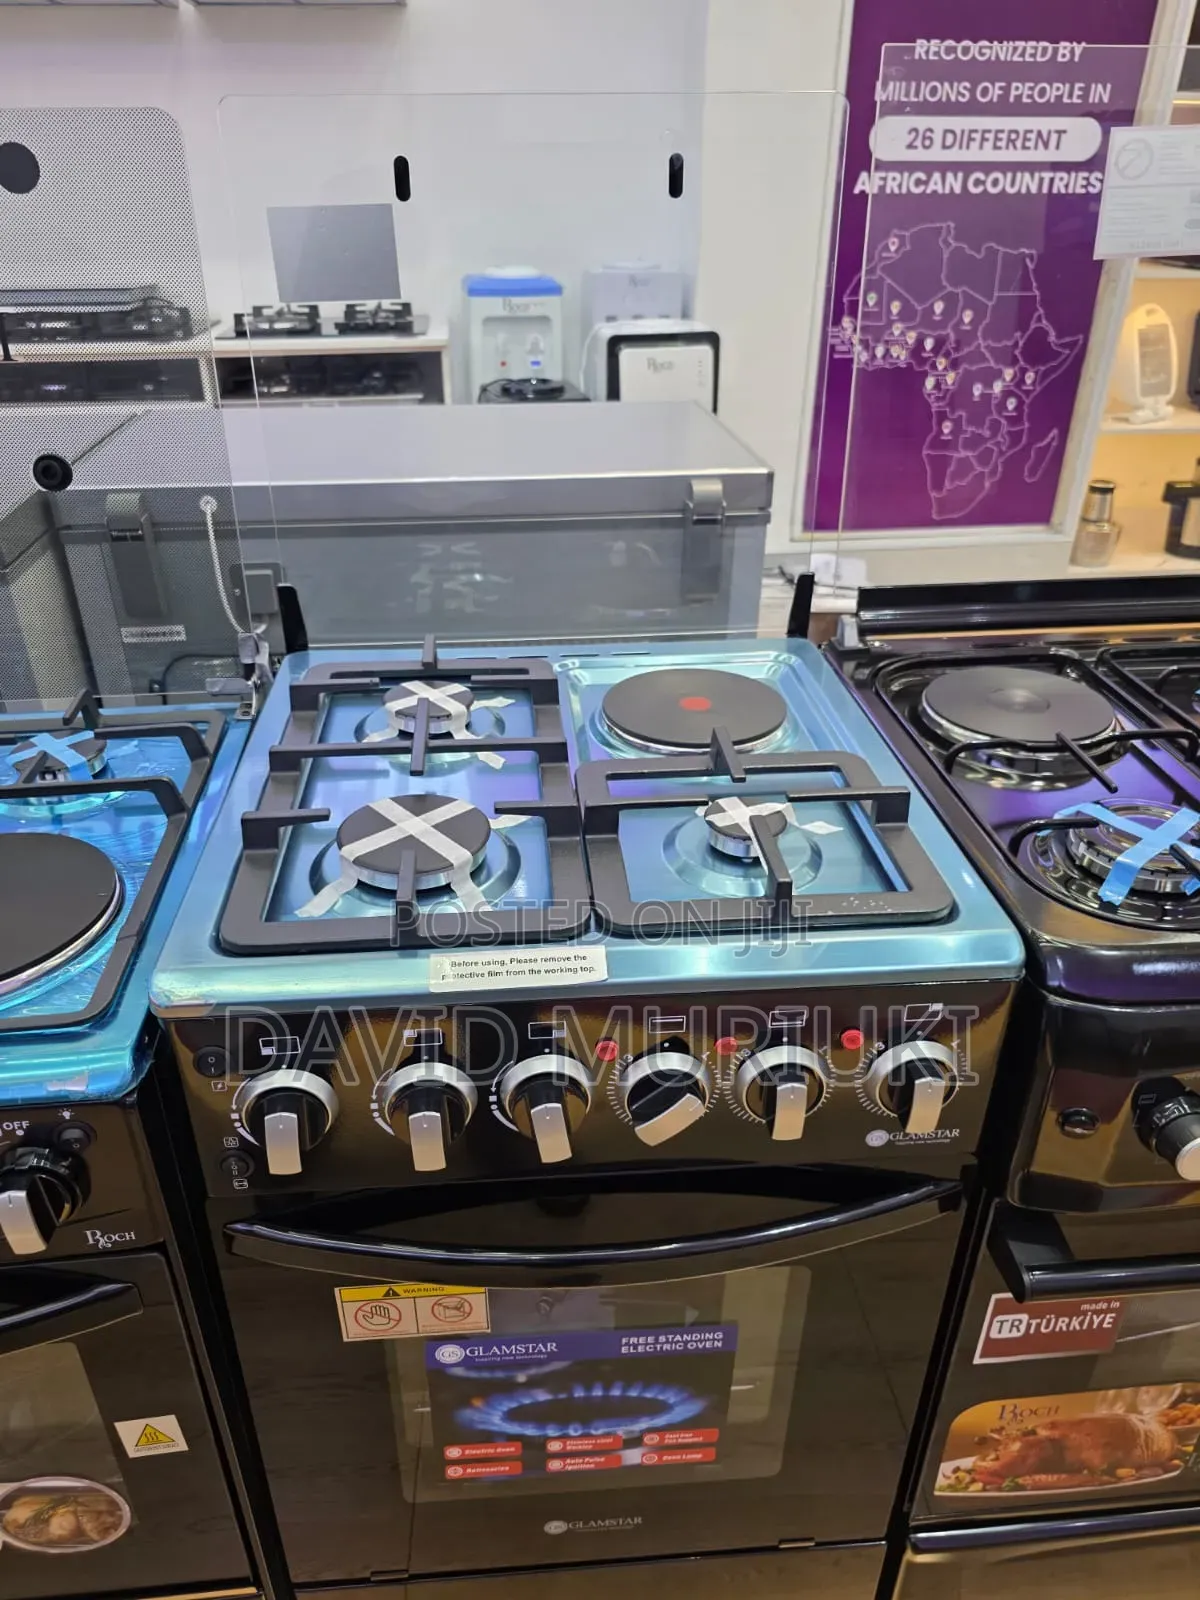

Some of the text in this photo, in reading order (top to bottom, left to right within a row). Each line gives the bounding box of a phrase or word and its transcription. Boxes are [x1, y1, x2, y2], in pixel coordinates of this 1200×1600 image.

[914, 39, 1086, 63] RECOGNIZED BY
[874, 81, 1111, 104] MILLIONS OF PEOPLE IN
[905, 127, 1067, 151] 26 DIFFERENT
[853, 171, 1103, 195] AFRICAN COUNTRIES
[451, 960, 480, 969] Before
[509, 957, 538, 966] Please
[574, 954, 587, 962] the
[441, 971, 485, 981] potective
[487, 970, 504, 978] film
[506, 969, 526, 977] from
[528, 968, 542, 976] the
[543, 966, 578, 976] working
[2, 1120, 30, 1130] OFF
[1080, 1300, 1120, 1311] made in
[995, 1311, 1116, 1335] TR TÜRKİYE
[621, 1331, 723, 1345] FREE STANDING
[466, 1342, 558, 1357] GLAMSTAR
[621, 1341, 723, 1354] ELECTRIC OVEN
